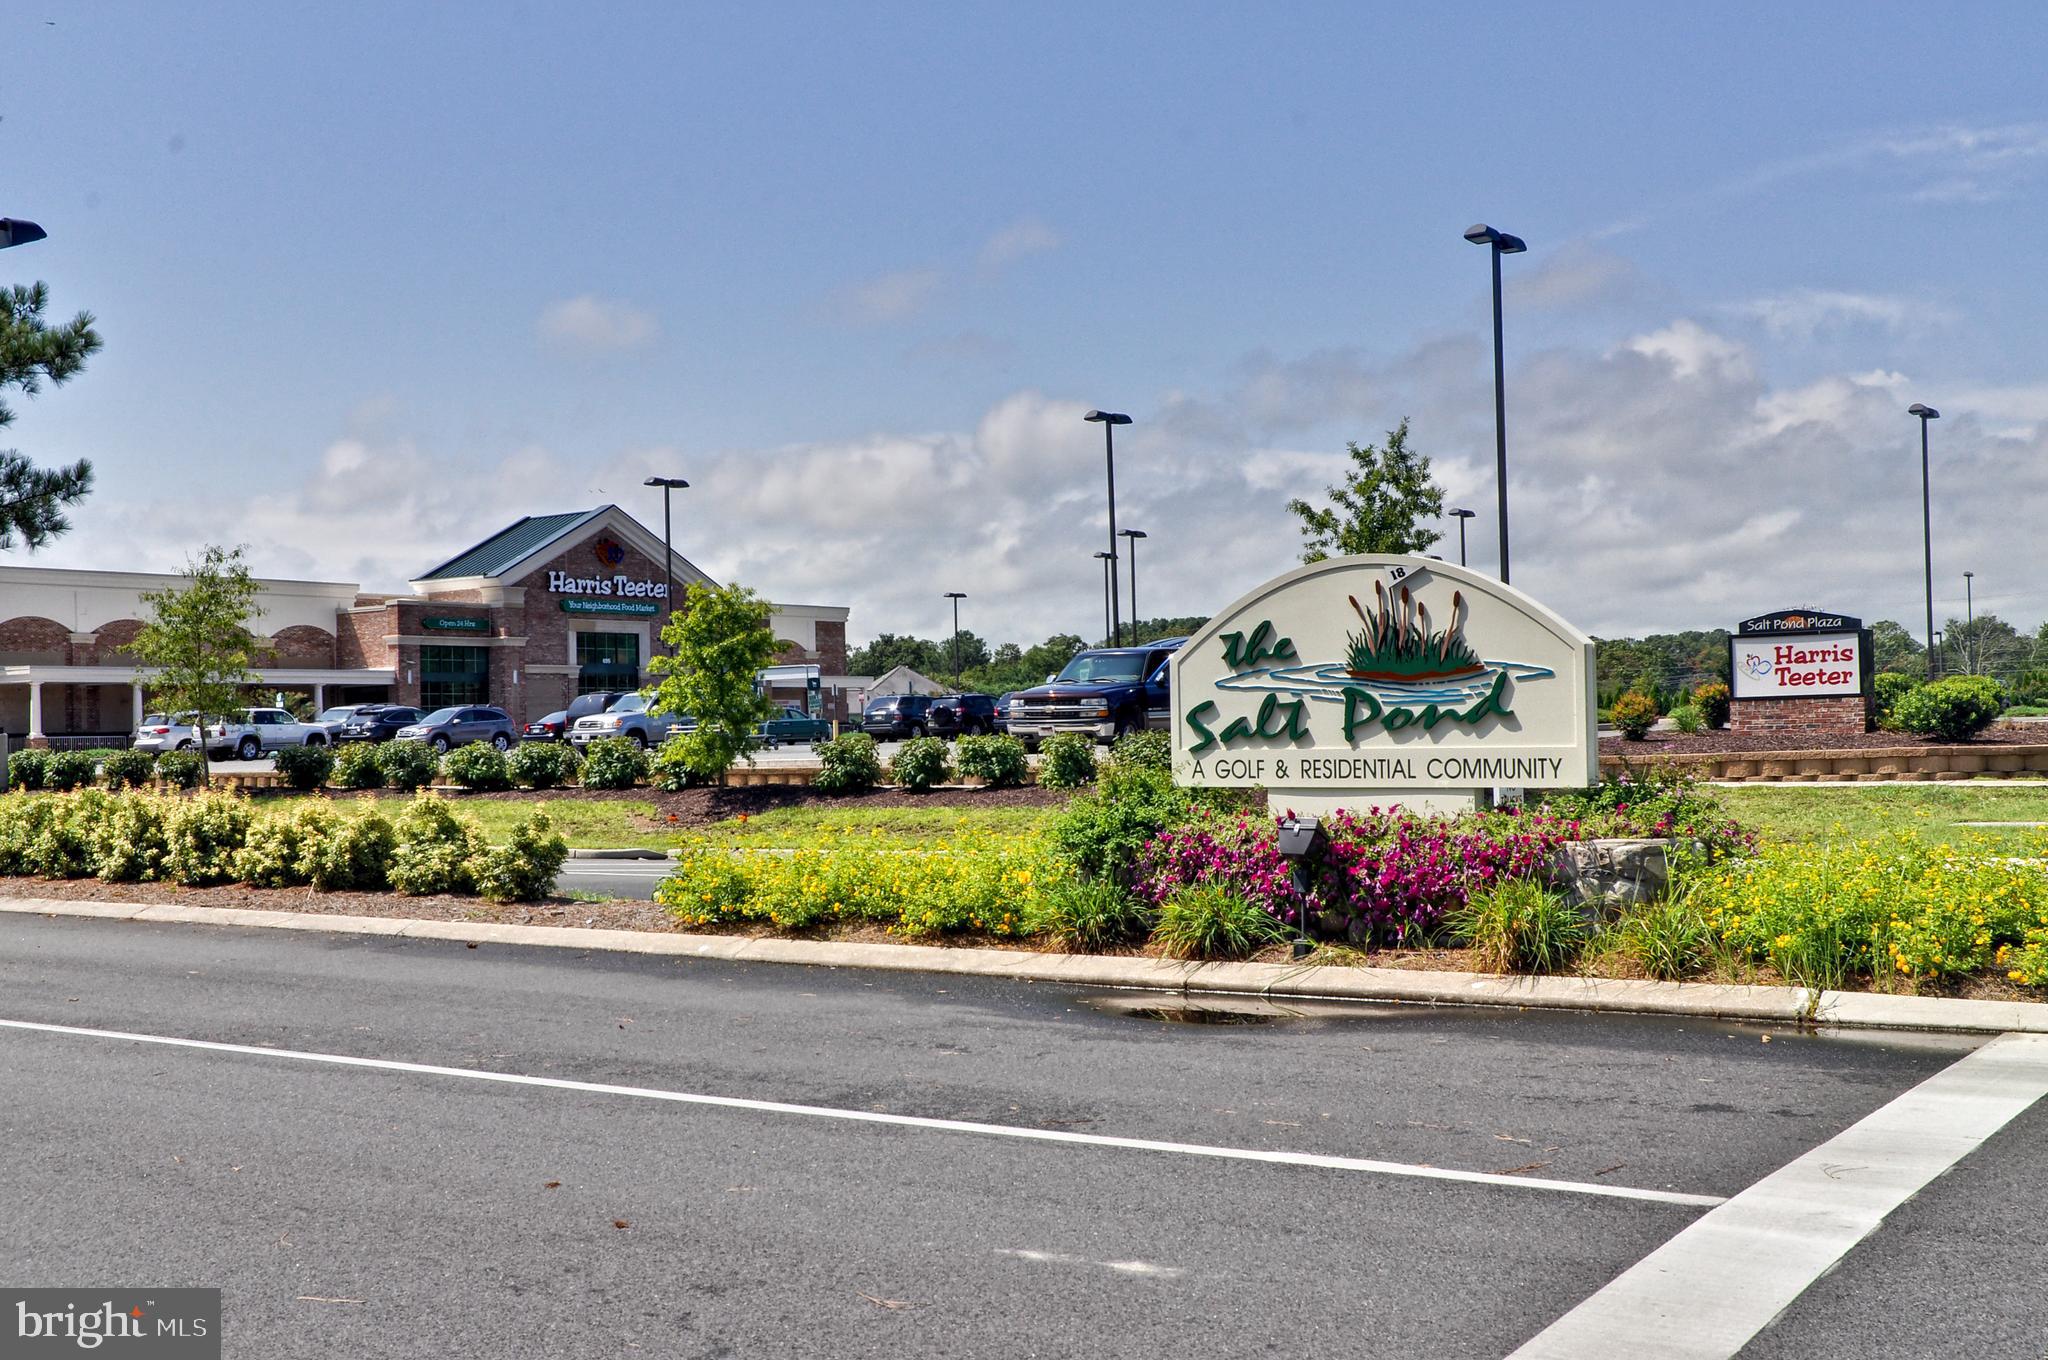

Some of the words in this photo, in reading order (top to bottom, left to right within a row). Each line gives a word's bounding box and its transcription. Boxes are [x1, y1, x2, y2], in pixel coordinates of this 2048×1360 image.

[549, 571, 612, 595] Harris
[1390, 567, 1406, 581] 18
[568, 600, 582, 609] Your
[621, 603, 635, 611] Food
[635, 604, 655, 612] Market
[440, 619, 456, 628] Open
[1747, 618, 1772, 631] Salt
[1773, 618, 1804, 630] Pond
[1807, 616, 1842, 629] Plaza
[1219, 620, 1298, 668] the
[1774, 643, 1854, 665] Harris
[1774, 666, 1853, 687] Teeter
[1186, 693, 1310, 753] Salt
[1342, 671, 1514, 743] Pond
[1192, 759, 1205, 779] A
[1215, 759, 1265, 779] GOLF
[1275, 759, 1290, 779] &
[1300, 759, 1416, 779] RESIDENTIAL
[1427, 757, 1562, 779] COMMUNITY
